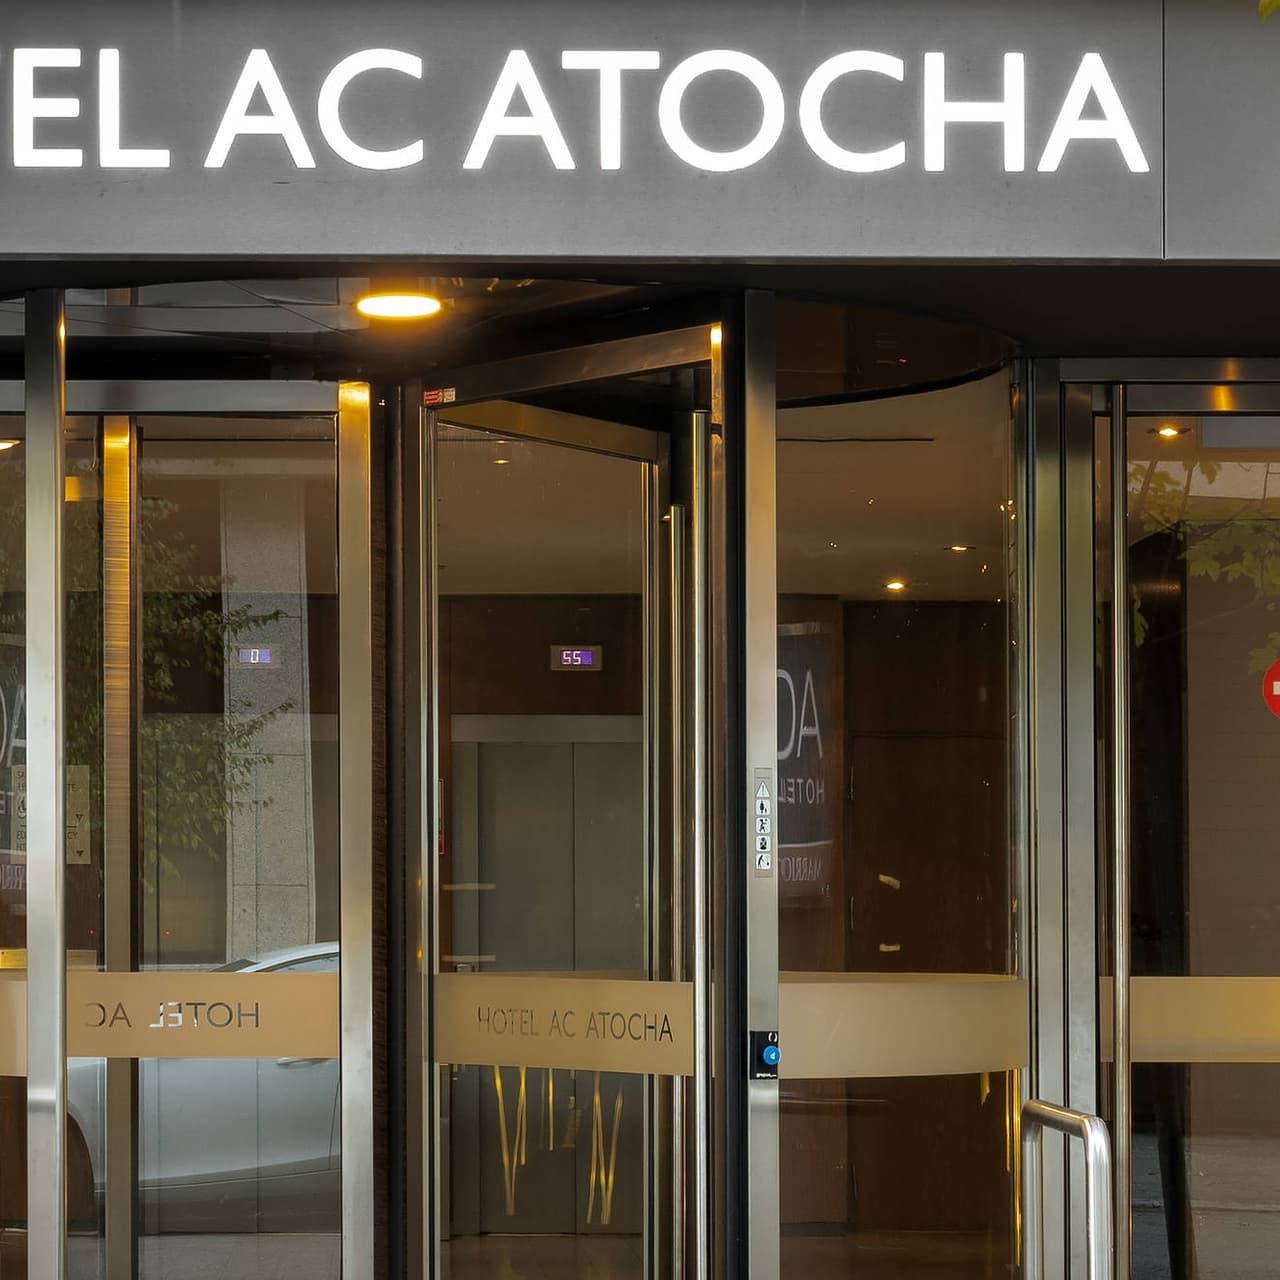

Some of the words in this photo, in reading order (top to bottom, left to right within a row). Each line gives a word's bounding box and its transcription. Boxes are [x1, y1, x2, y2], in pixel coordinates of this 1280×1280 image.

[203, 48, 425, 171] AC
[462, 49, 1152, 174] ATOCHA
[477, 1006, 539, 1037] HOTEL
[548, 1009, 576, 1039] AC
[585, 1011, 674, 1043] ATOCHA
